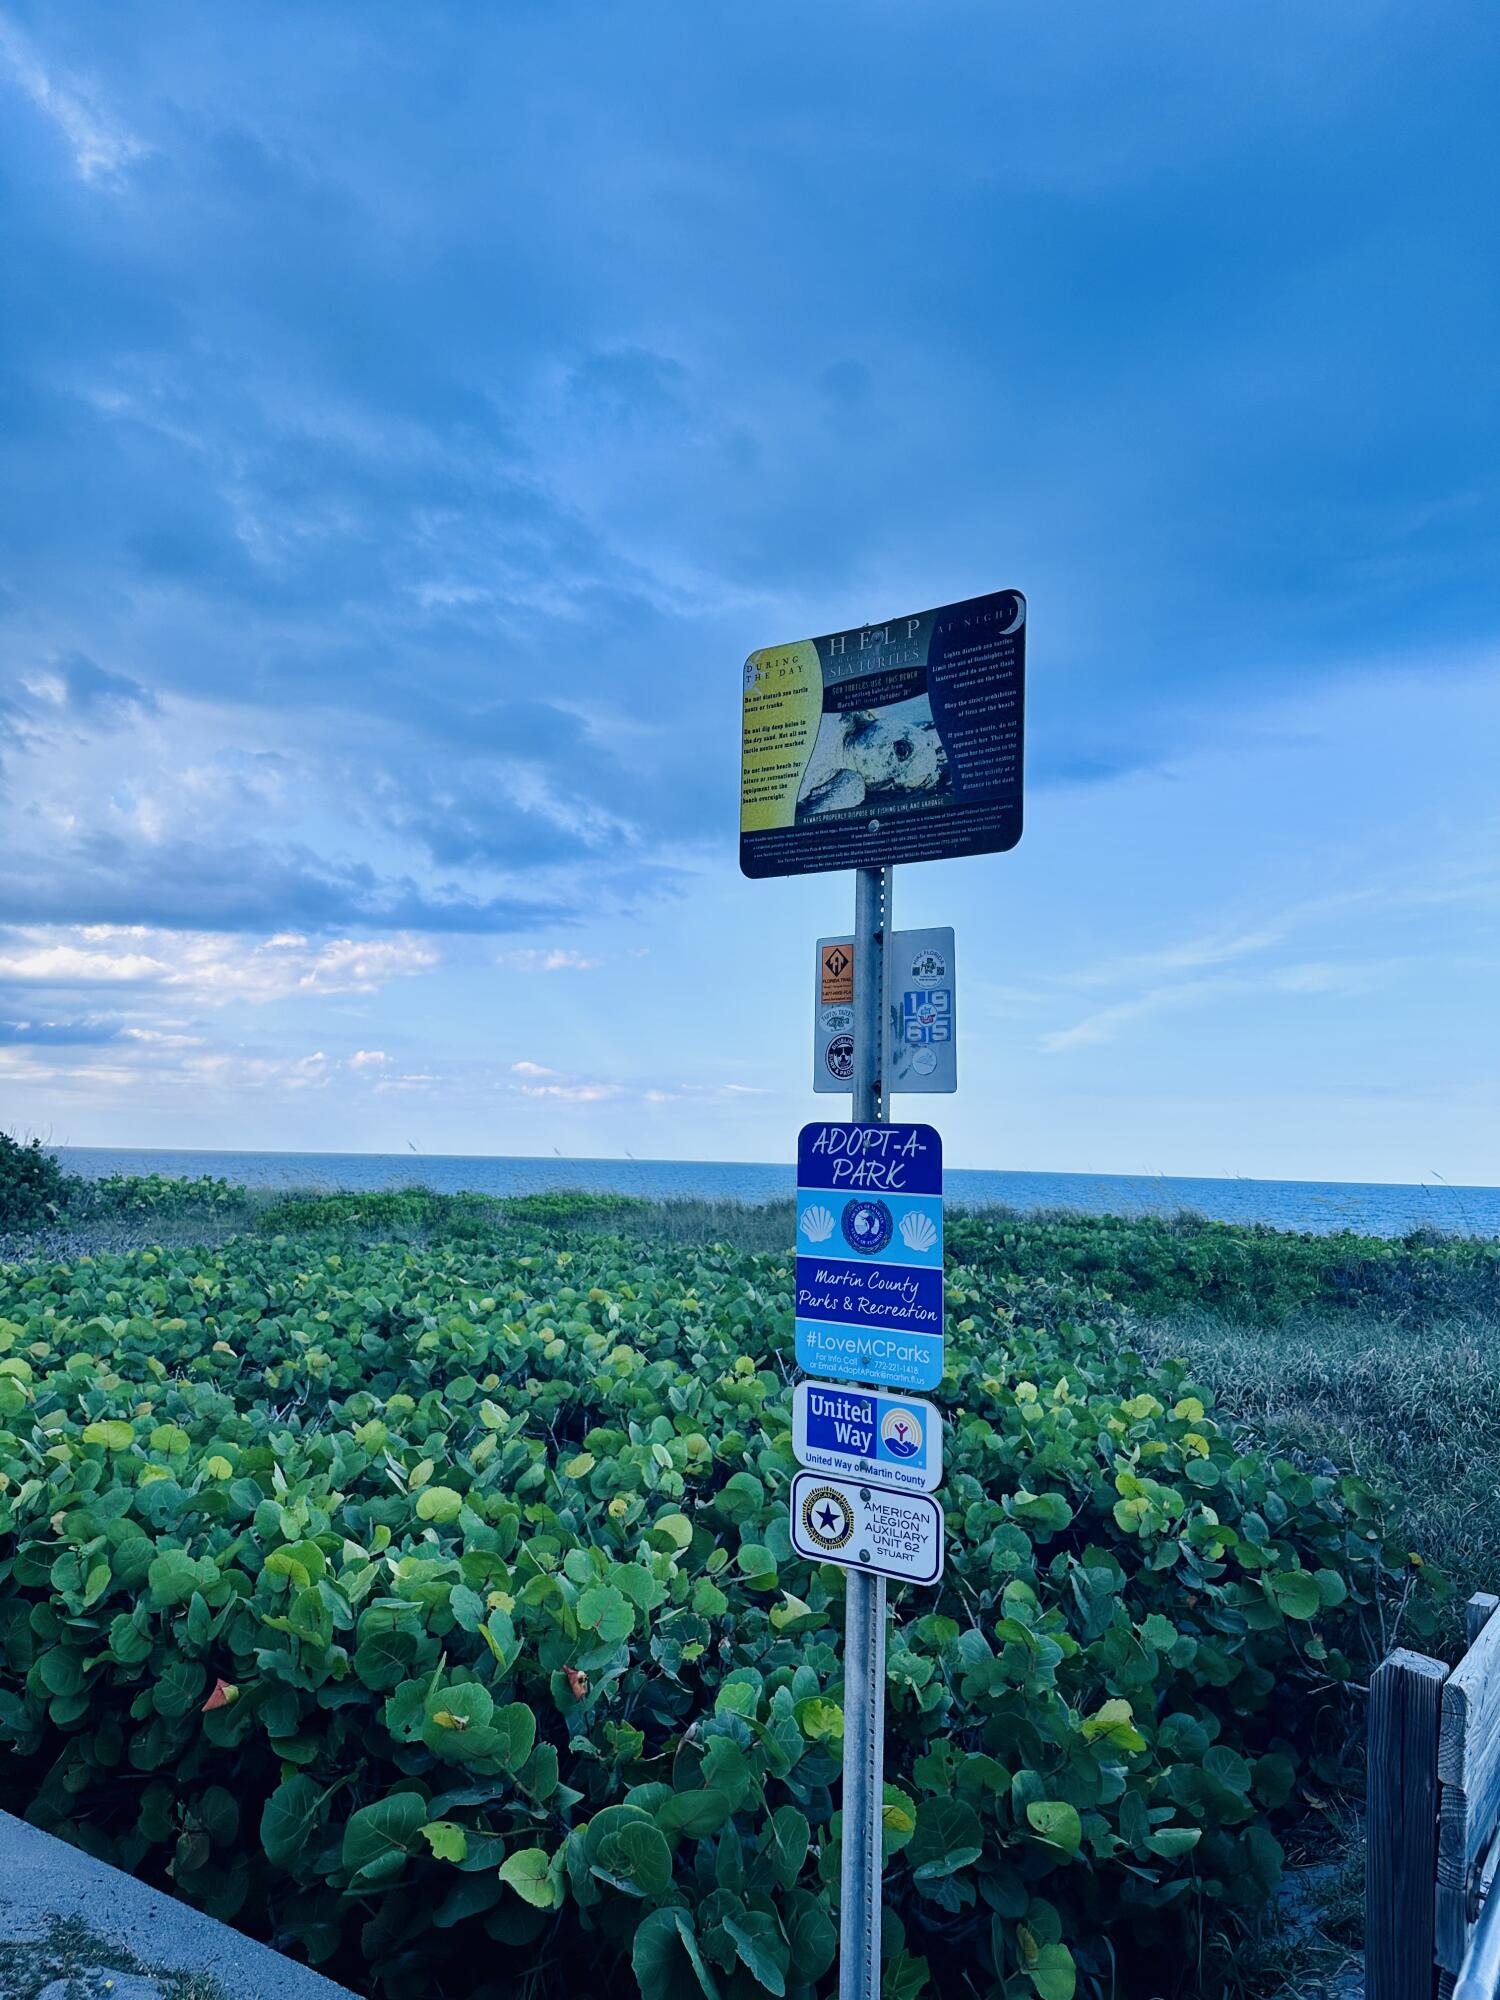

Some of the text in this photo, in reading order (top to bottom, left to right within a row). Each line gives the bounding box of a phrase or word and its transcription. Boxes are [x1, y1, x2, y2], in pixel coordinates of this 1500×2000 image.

[938, 608, 1015, 633] AT NIGHT
[830, 619, 920, 656] HELP
[746, 656, 799, 673] DURING
[746, 665, 804, 682] THE DAY
[830, 664, 854, 676] SEA
[857, 650, 919, 672] TURTLES
[803, 815, 822, 824] ALWAYS
[822, 812, 847, 822] PROPERLY
[848, 810, 868, 818] DISPOSE
[877, 805, 896, 814] FISHING
[921, 798, 944, 808] GARBAGE
[923, 950, 944, 965] FLORIDA
[832, 1038, 854, 1050] BLUELIN
[812, 1127, 926, 1157] ADOPT-A-
[832, 1158, 906, 1189] PARK
[815, 1270, 919, 1303] Martin County
[800, 1290, 938, 1320] Parks & Recreation
[806, 1330, 930, 1364] #LoveMCParks
[816, 1353, 827, 1361] For
[844, 1355, 858, 1365] Call
[874, 1360, 918, 1374] 772-221-1418
[818, 1362, 837, 1372] Email
[838, 1364, 925, 1385] AdoptAPark@martin.fl.us
[810, 1394, 873, 1424] United
[834, 1422, 872, 1453] Way
[805, 1452, 832, 1466] United
[834, 1458, 852, 1471] Way
[864, 1464, 893, 1479] Martin
[894, 1471, 926, 1487] County
[807, 1492, 850, 1523] AMERICAN LEGION
[864, 1501, 930, 1524] AMERICAN
[810, 1527, 844, 1544] AUXILIARY
[865, 1523, 928, 1544] AUXILIARY
[873, 1514, 919, 1532] LEGION
[873, 1534, 920, 1552] UNIT 62
[877, 1547, 915, 1562] STUART
